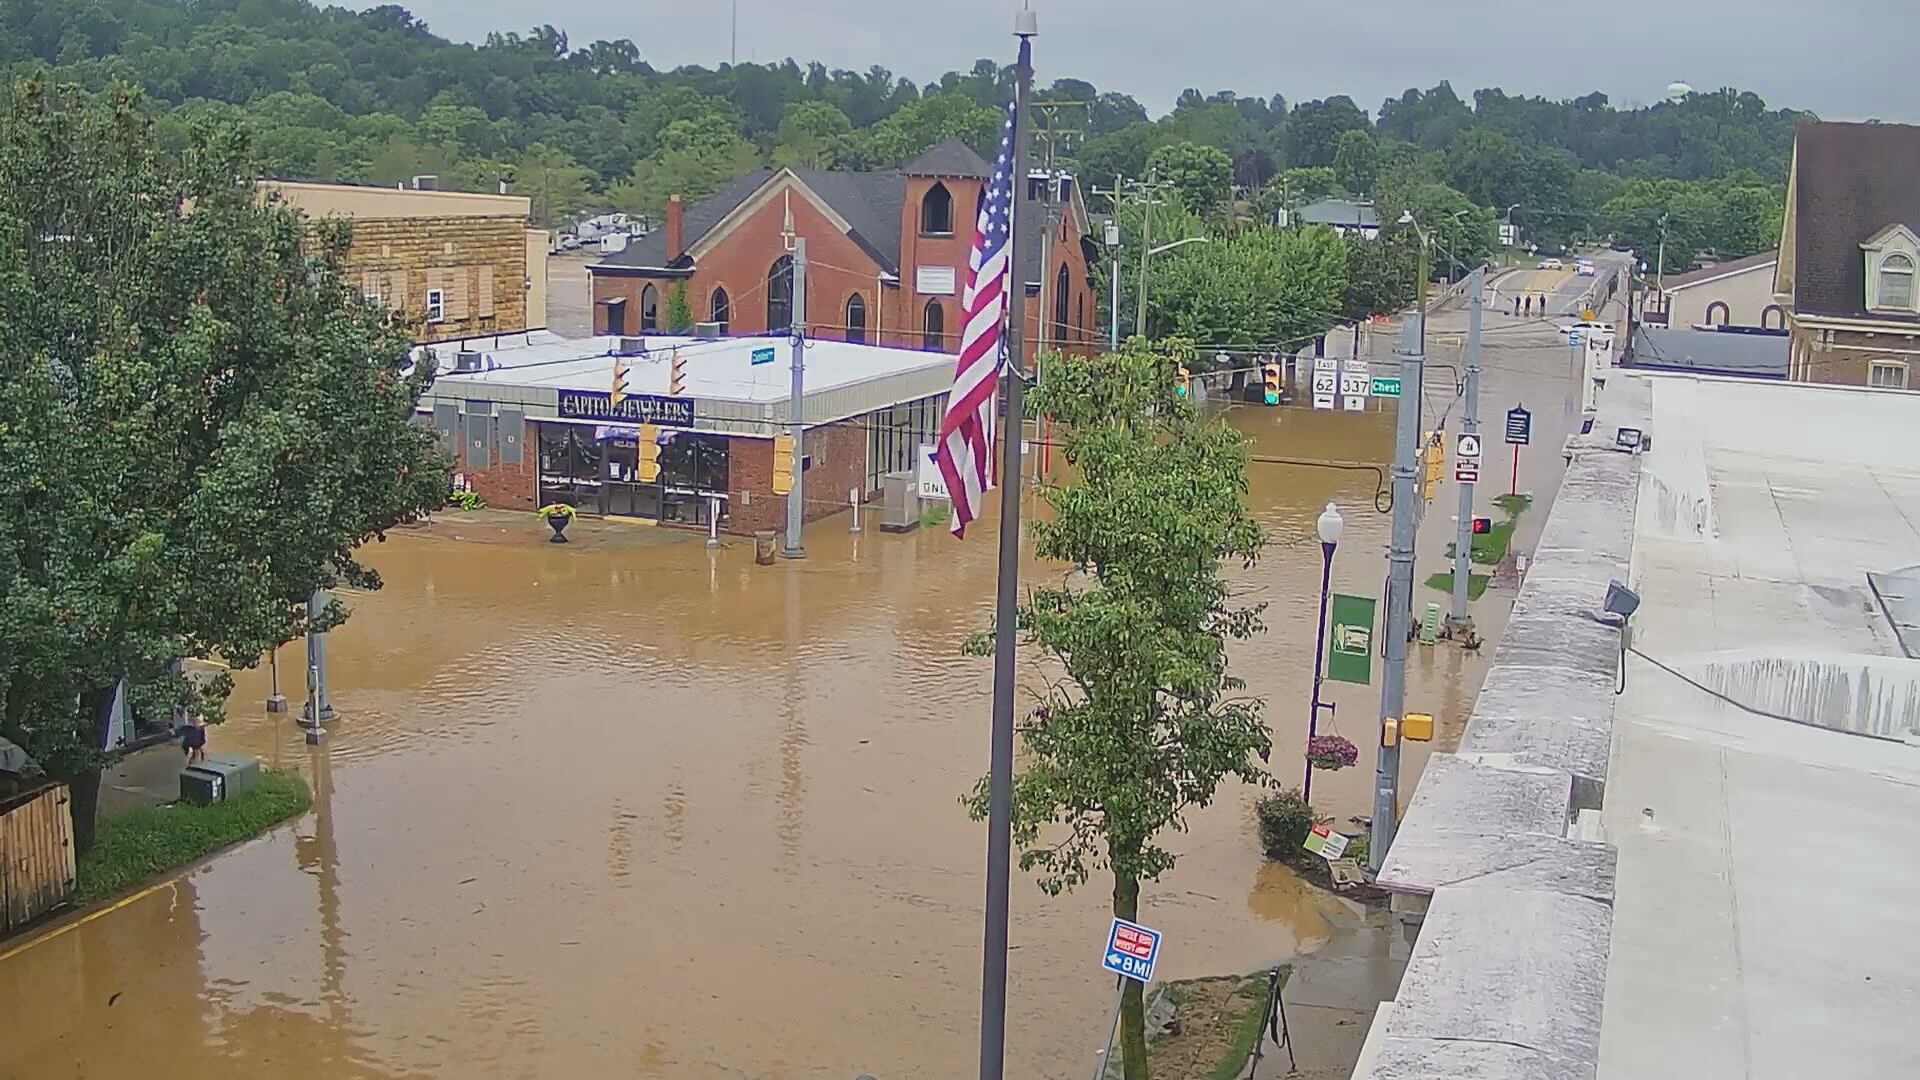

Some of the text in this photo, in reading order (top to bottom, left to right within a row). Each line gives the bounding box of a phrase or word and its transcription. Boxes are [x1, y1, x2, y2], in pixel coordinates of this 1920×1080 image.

[1316, 379, 1333, 391] 62
[1342, 379, 1368, 393] 337
[563, 394, 690, 423] CAPITOL JEWELERS
[923, 482, 945, 495] ONL
